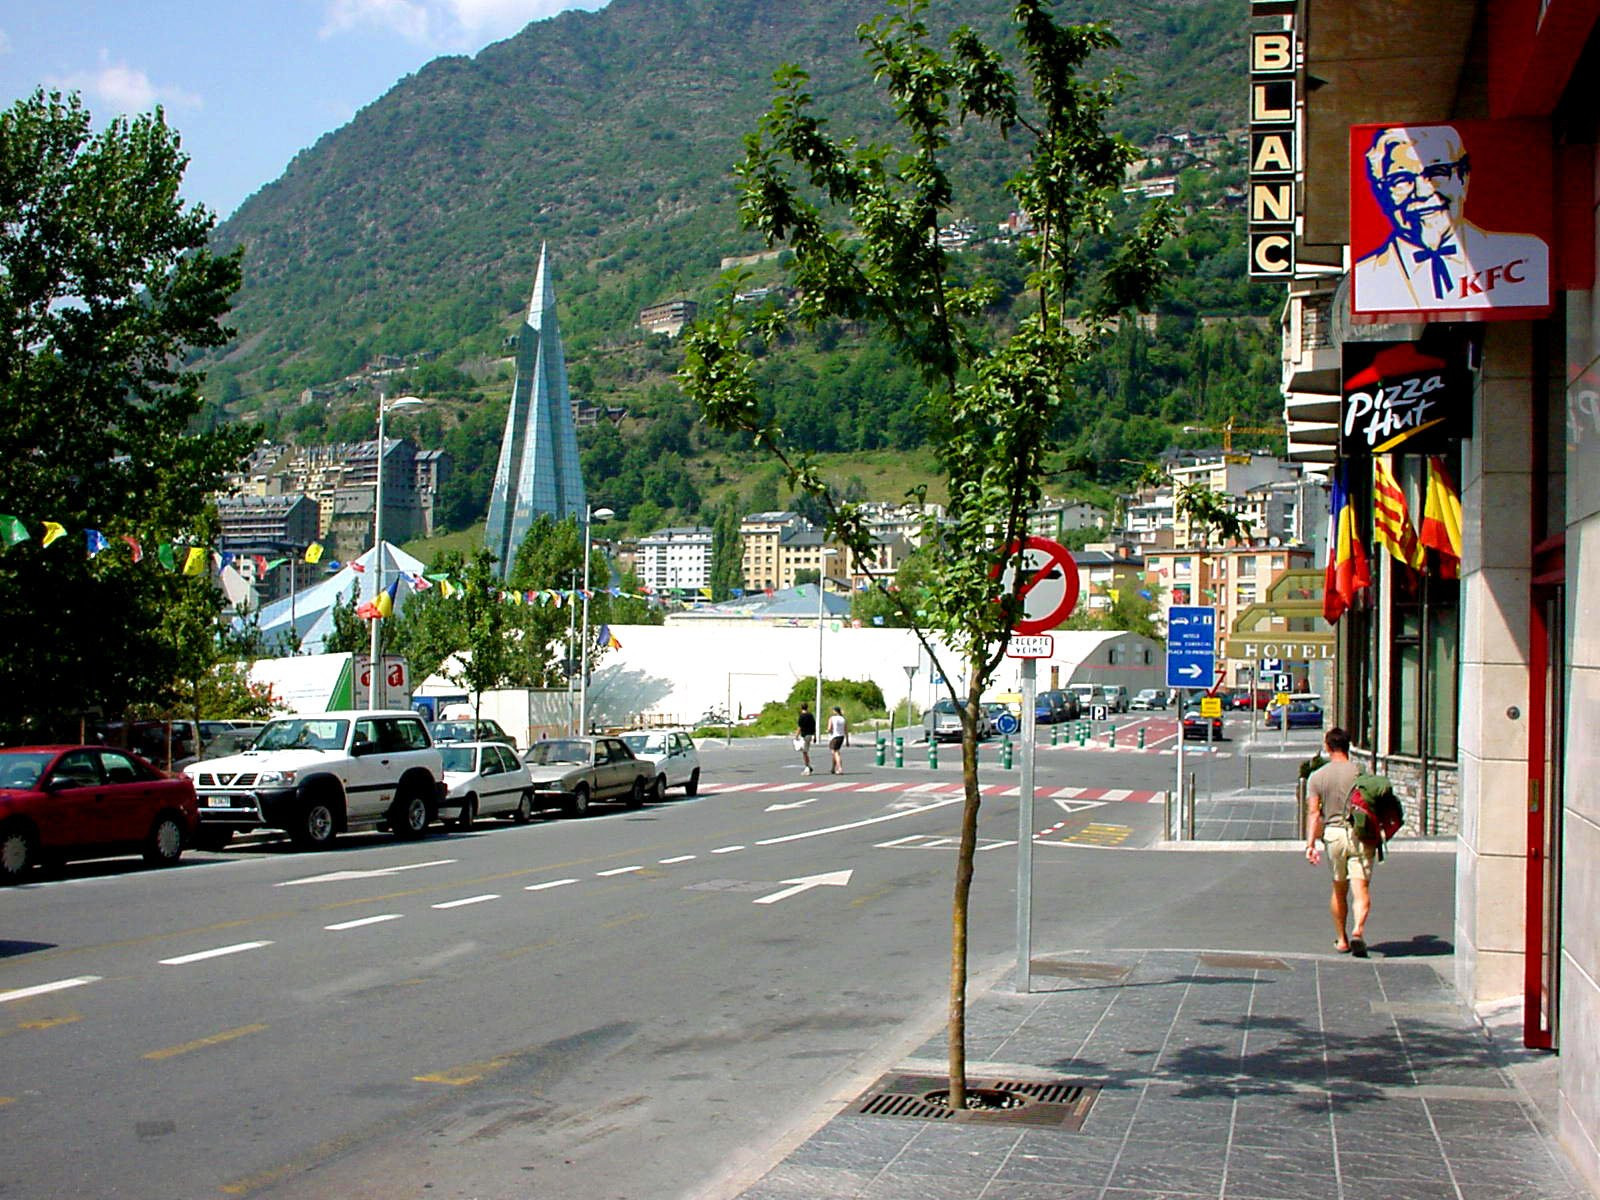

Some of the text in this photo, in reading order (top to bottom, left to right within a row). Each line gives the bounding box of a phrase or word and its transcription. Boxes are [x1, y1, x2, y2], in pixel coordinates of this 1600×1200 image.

[1254, 35, 1292, 272] BLANC
[1458, 258, 1526, 299] KFC
[1344, 375, 1445, 437] Pizza
[1363, 401, 1436, 445] Hut
[1244, 643, 1336, 659] HOTEL
